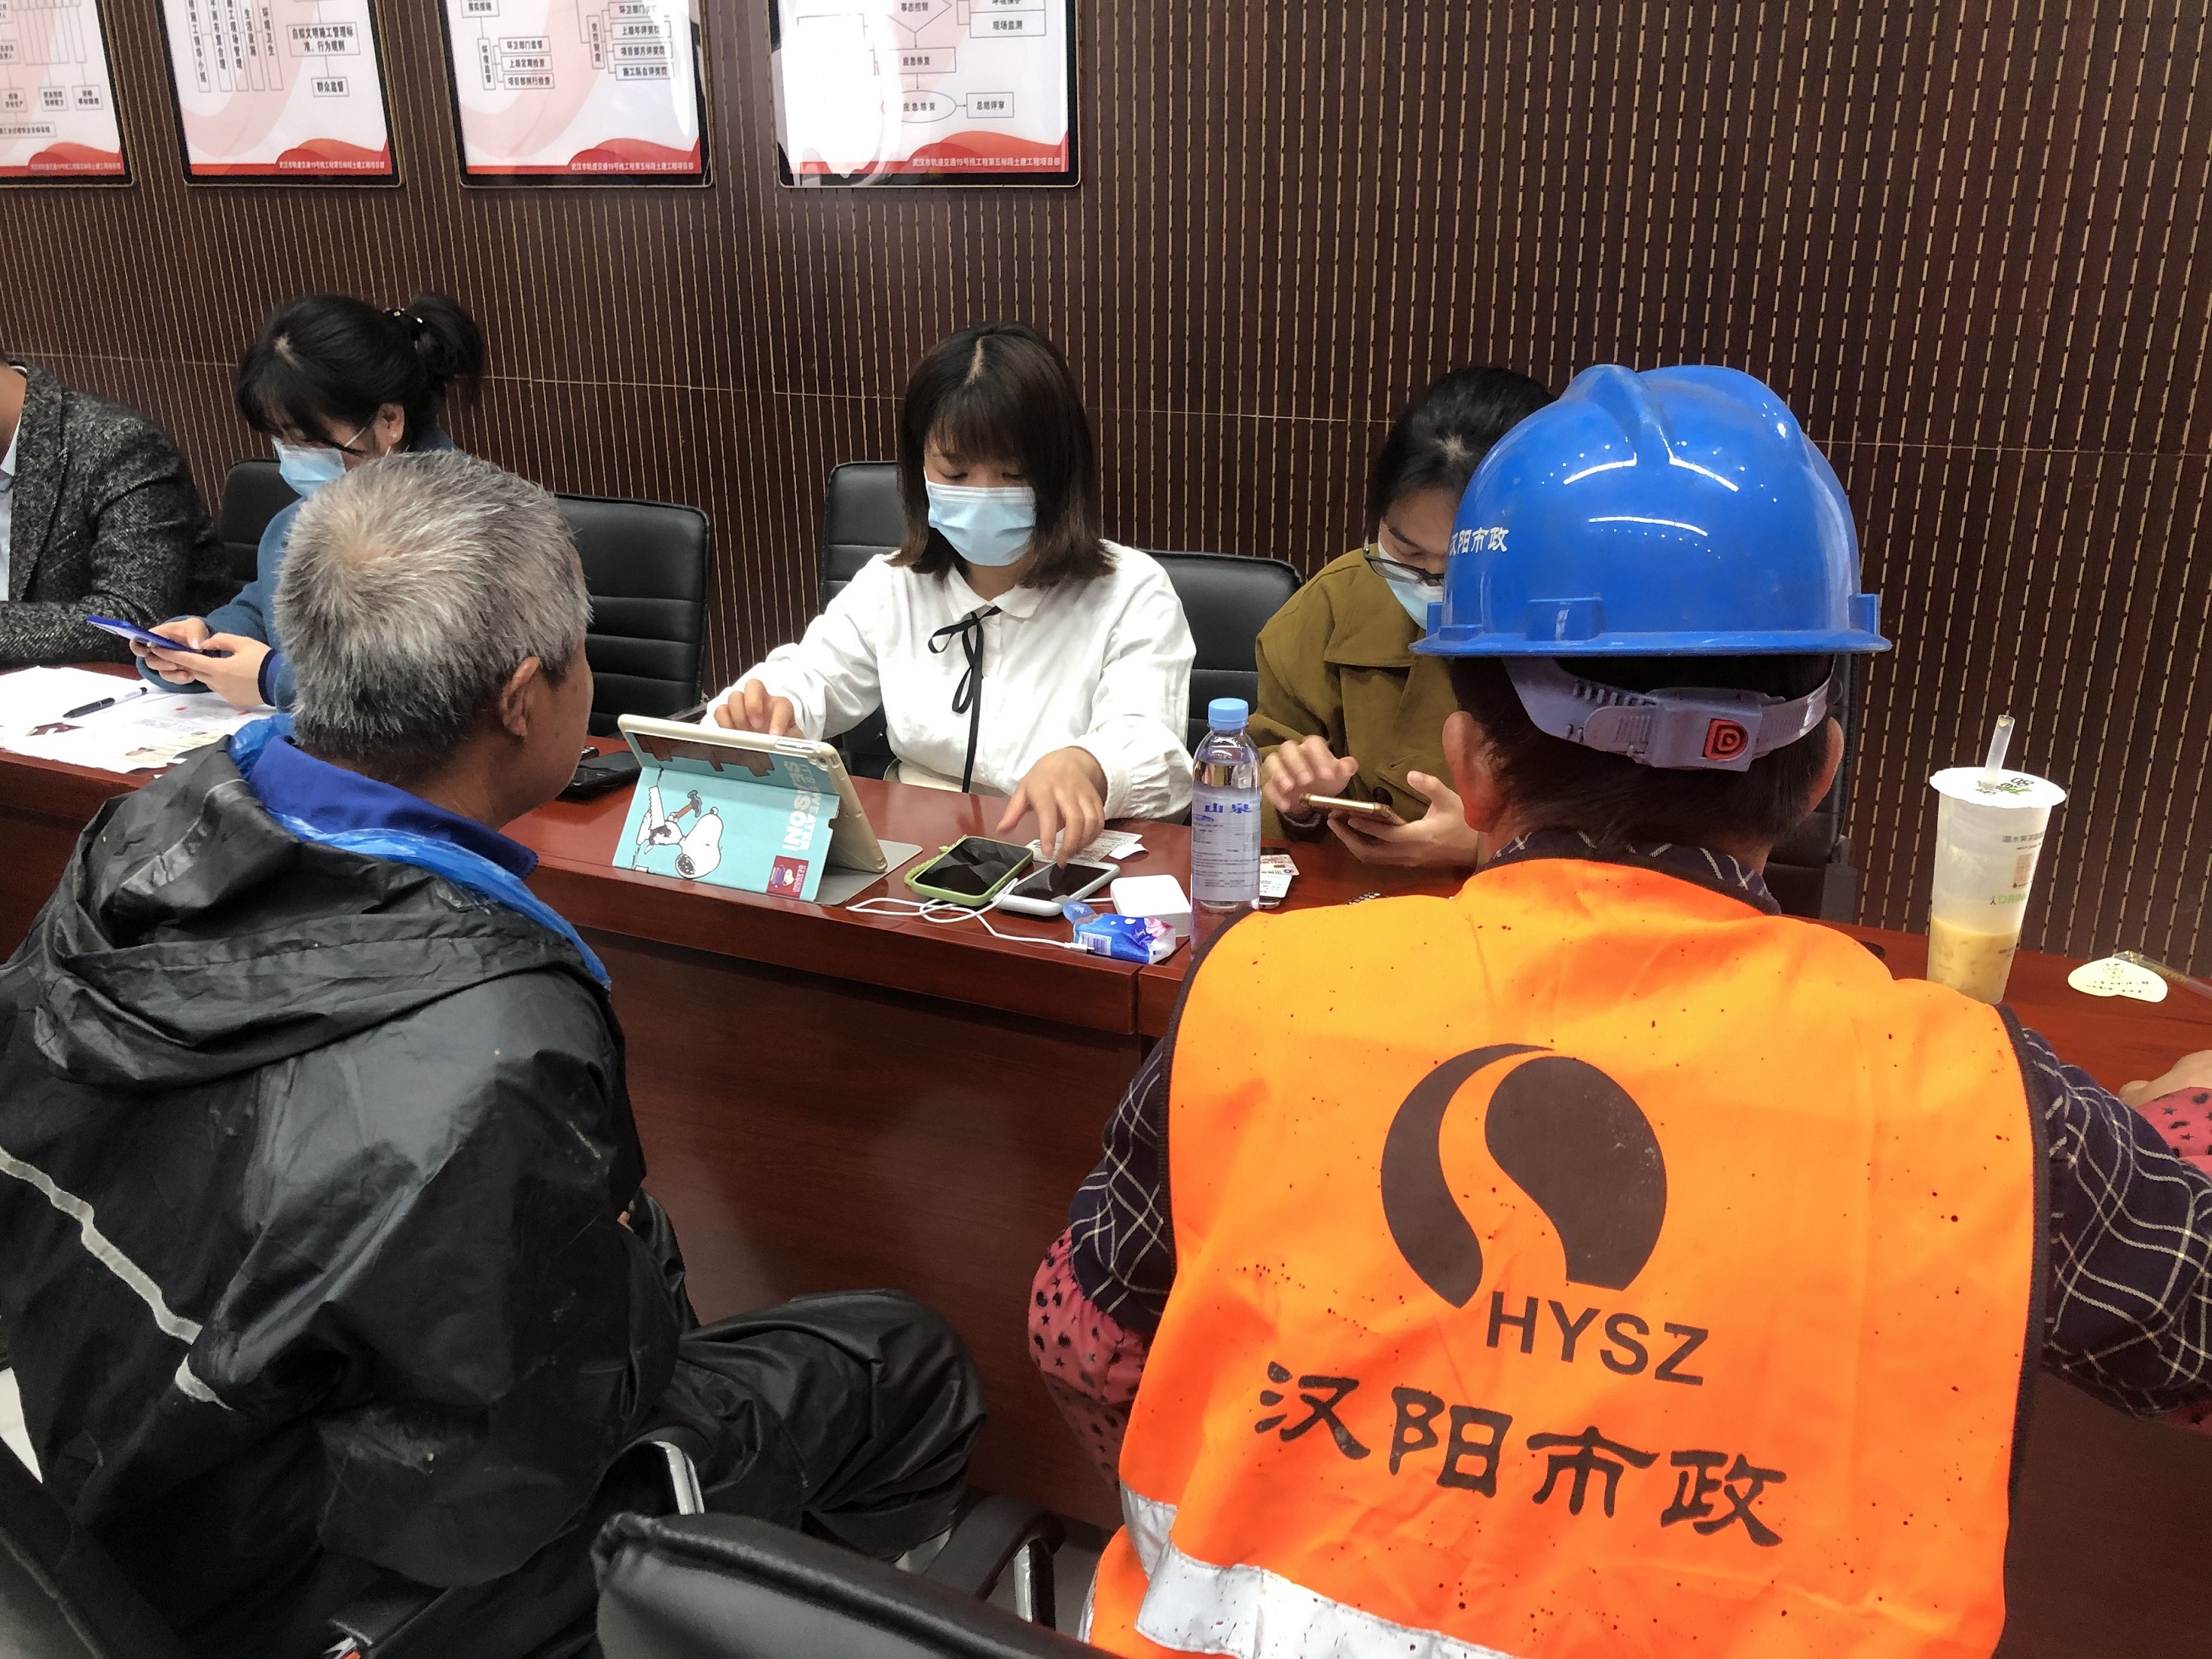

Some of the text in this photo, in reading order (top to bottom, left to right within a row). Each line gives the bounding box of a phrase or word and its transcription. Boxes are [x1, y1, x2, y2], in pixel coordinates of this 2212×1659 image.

[900, 2, 929, 12] 事态控制
[993, 21, 1023, 30] 现场监测
[903, 56, 930, 66] 应急恢复
[316, 81, 344, 93] 群众监督
[977, 101, 1005, 110] 总结评审
[1486, 1291, 1709, 1386] HYSZ
[1255, 1360, 1787, 1547] 汉阳市政
